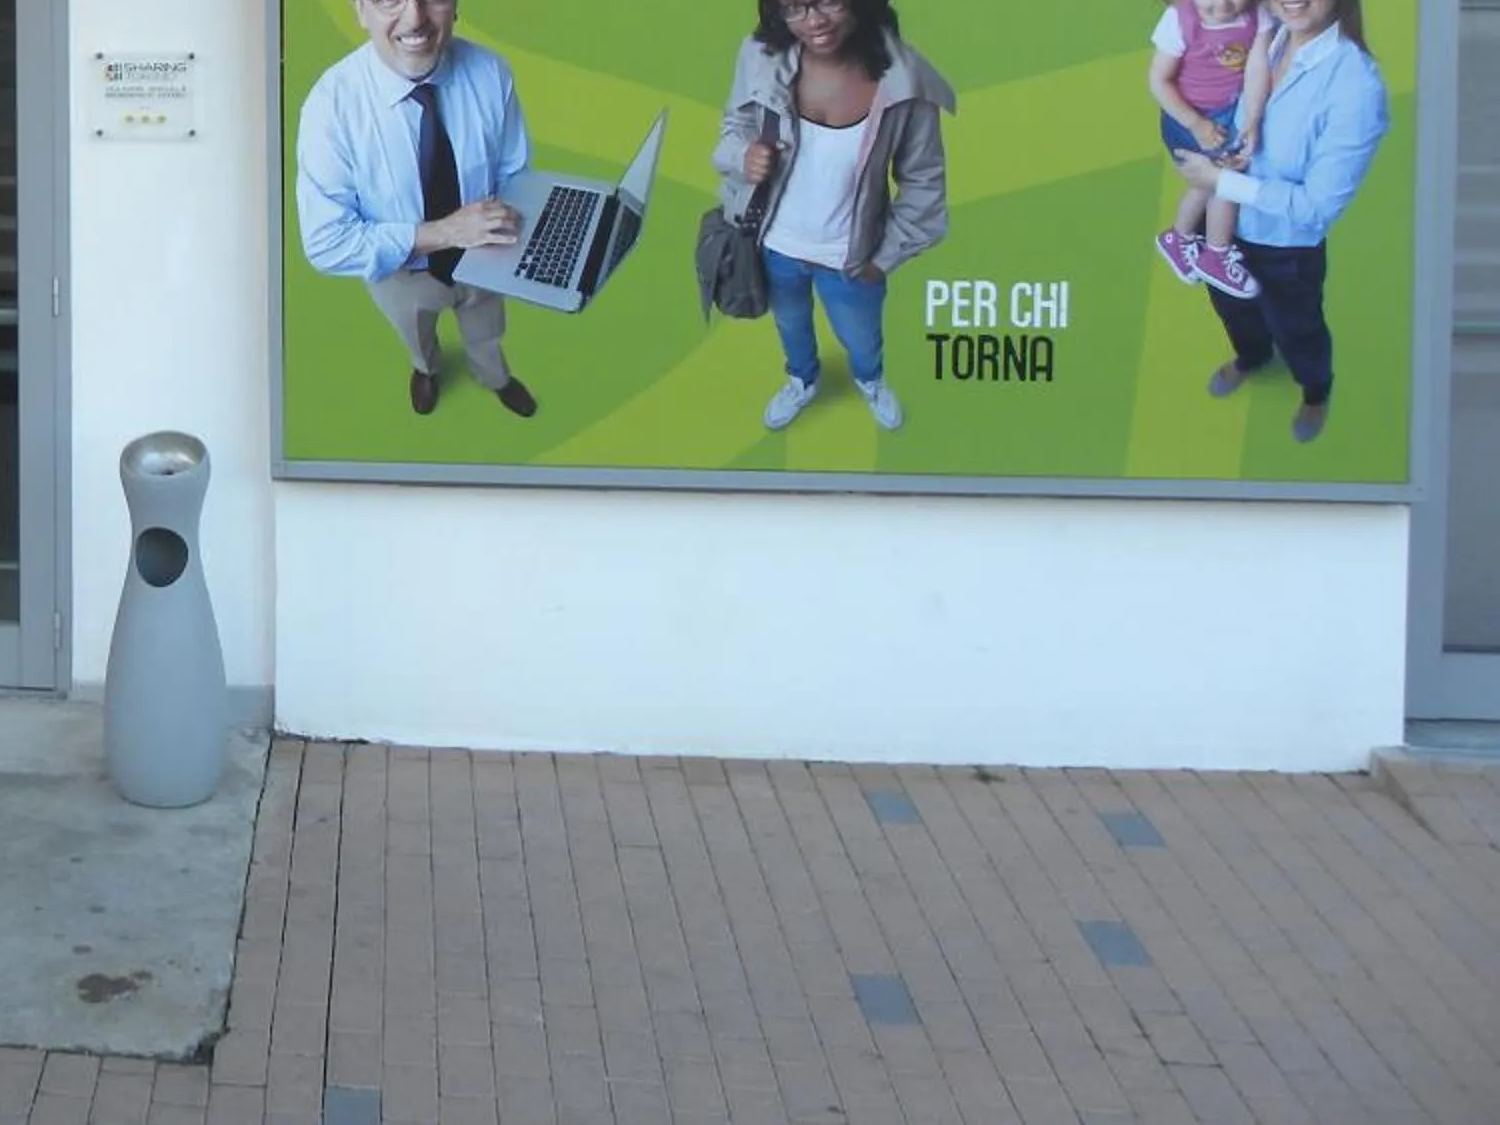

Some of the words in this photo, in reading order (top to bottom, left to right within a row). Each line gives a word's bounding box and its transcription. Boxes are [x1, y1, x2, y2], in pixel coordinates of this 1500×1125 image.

[926, 279, 998, 328] PER
[1010, 280, 1070, 330] CHI
[925, 333, 1054, 382] TORNA
